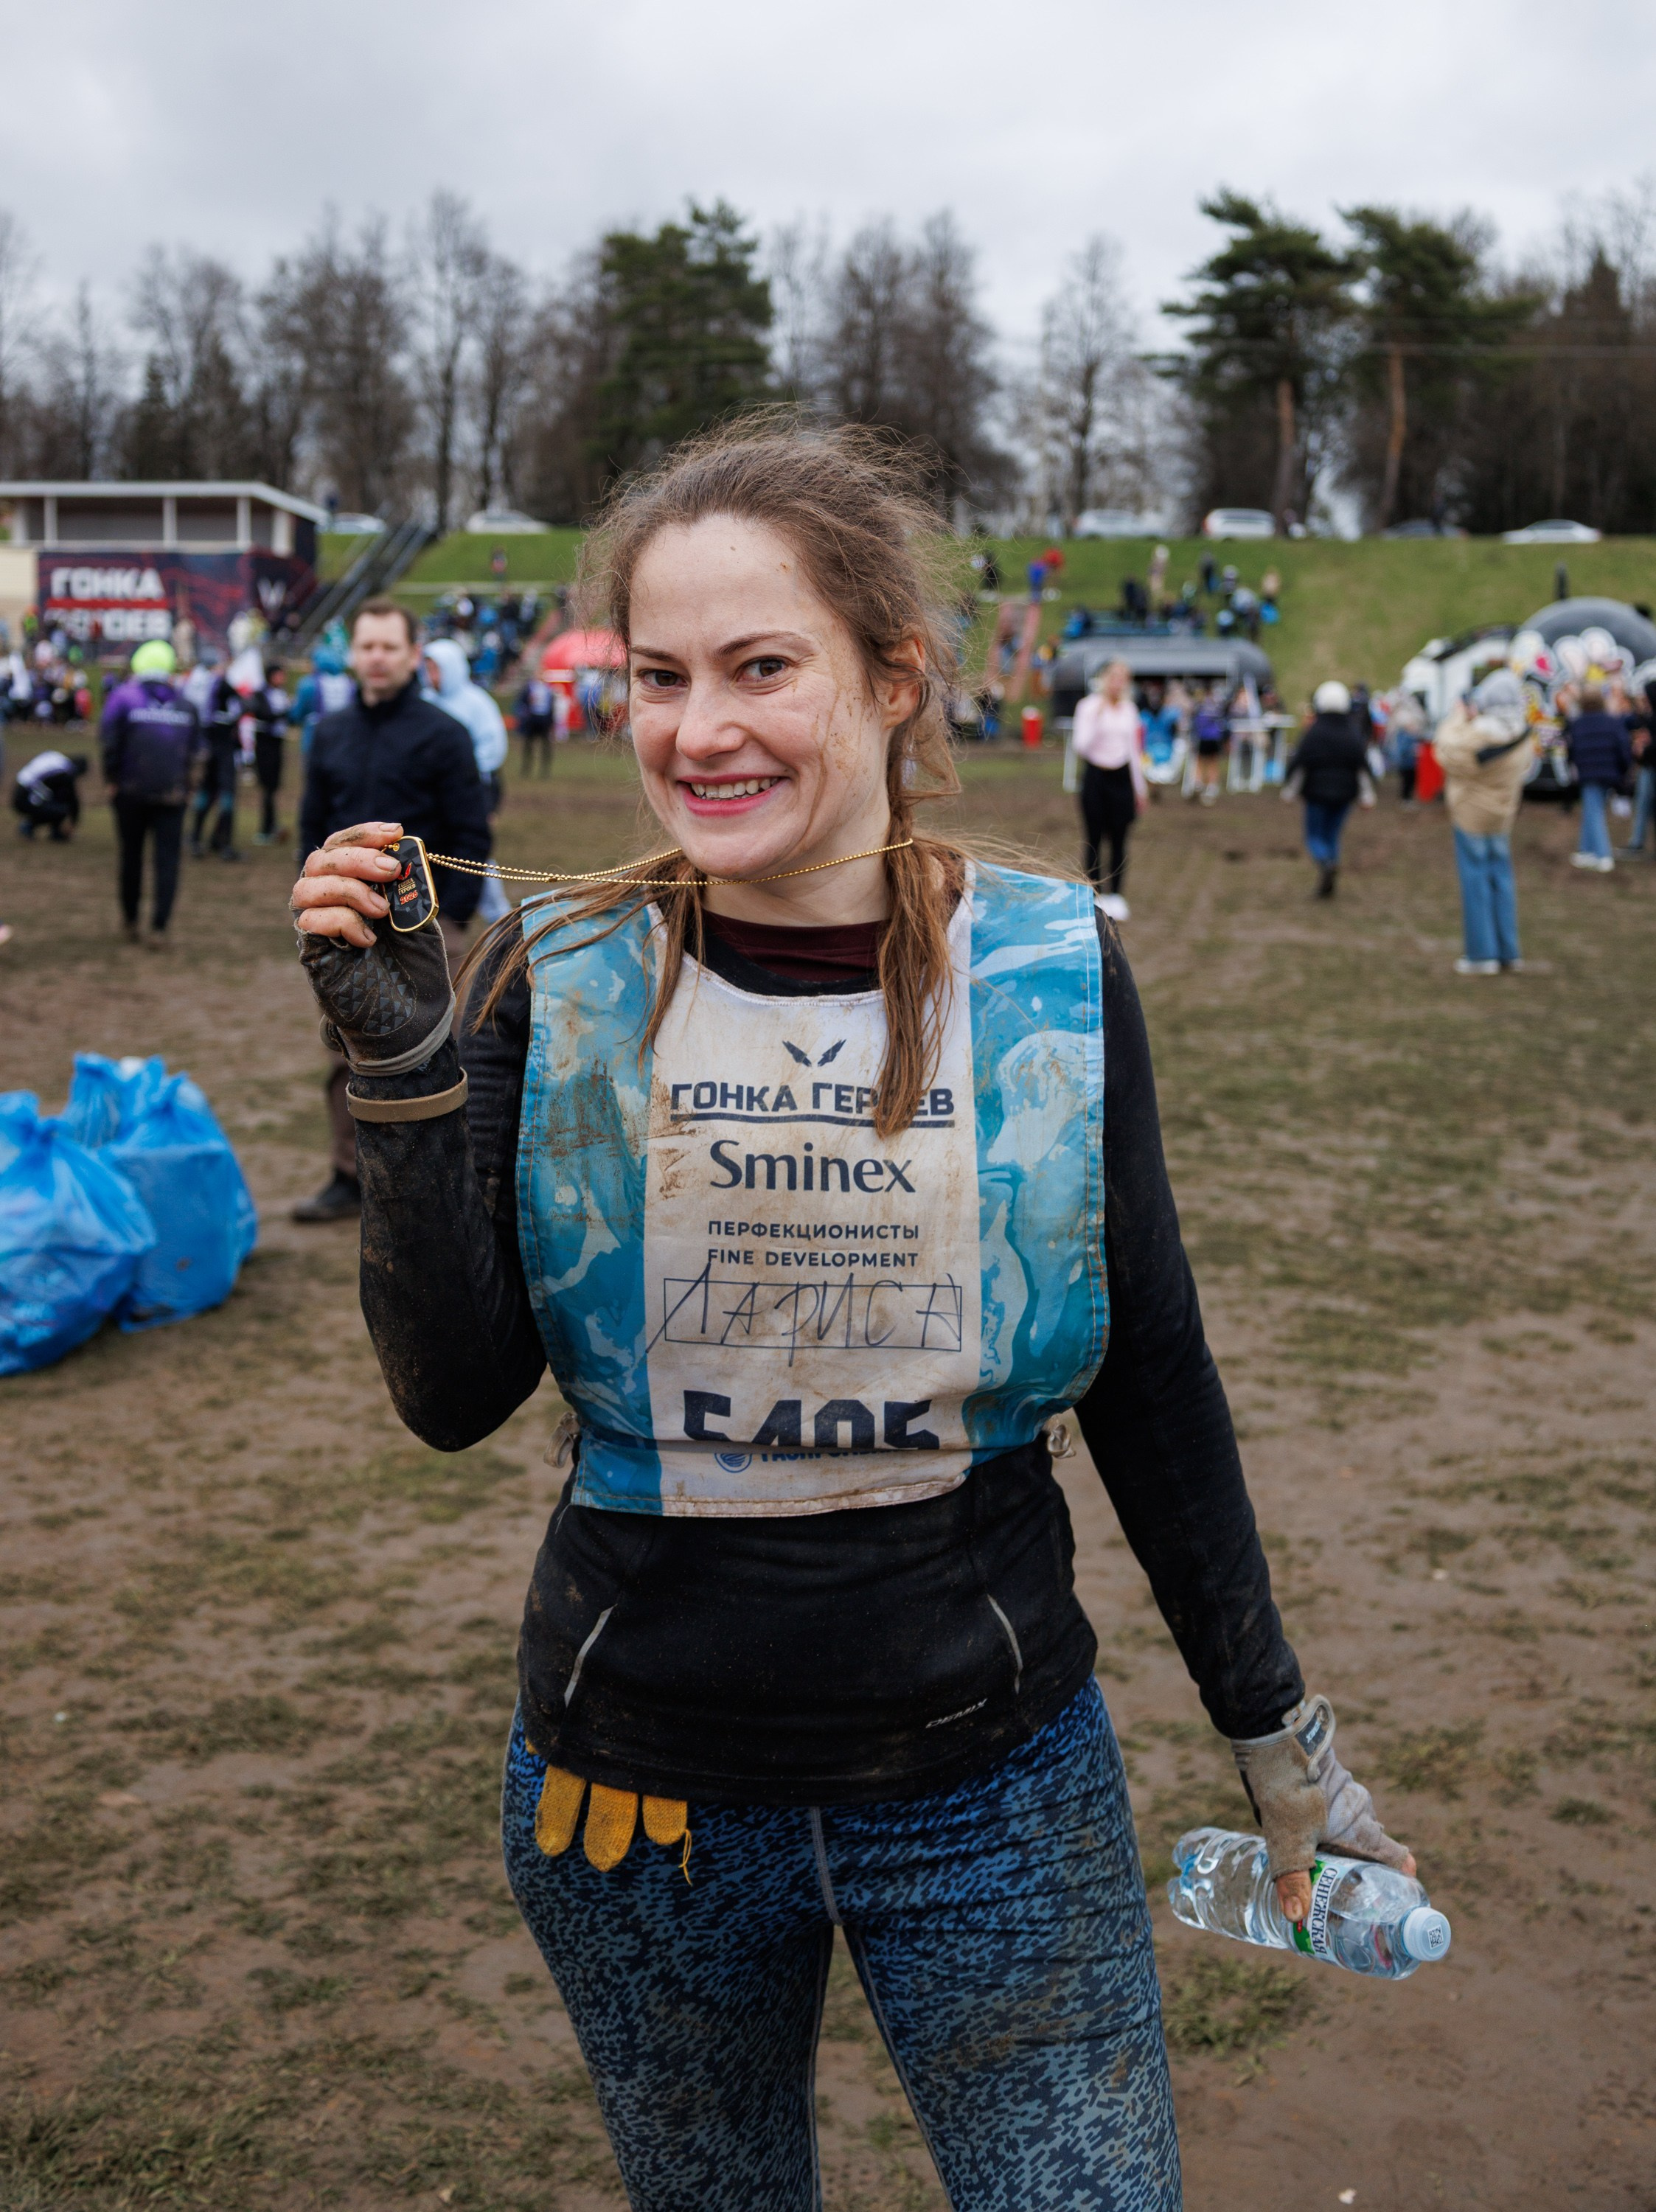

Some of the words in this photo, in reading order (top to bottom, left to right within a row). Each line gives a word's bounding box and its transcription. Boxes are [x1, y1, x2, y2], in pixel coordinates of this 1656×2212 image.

[49, 566, 167, 600] ГОНКА
[399, 883, 416, 895] ГЕРОЕВ
[400, 889, 418, 905] 2026
[670, 1081, 798, 1112] ГОНКА
[812, 1082, 954, 1115] ГЕРВ
[709, 1139, 916, 1192] Sminex
[709, 1220, 919, 1240] ПЕРФЕКЦИОНИСТЫ
[708, 1249, 754, 1265] FINE
[765, 1252, 918, 1267] DEVELOPMENT
[646, 1262, 961, 1367] ЛАРИСА
[1311, 1867, 1338, 1955] СЕНЕЖСКАЯ
